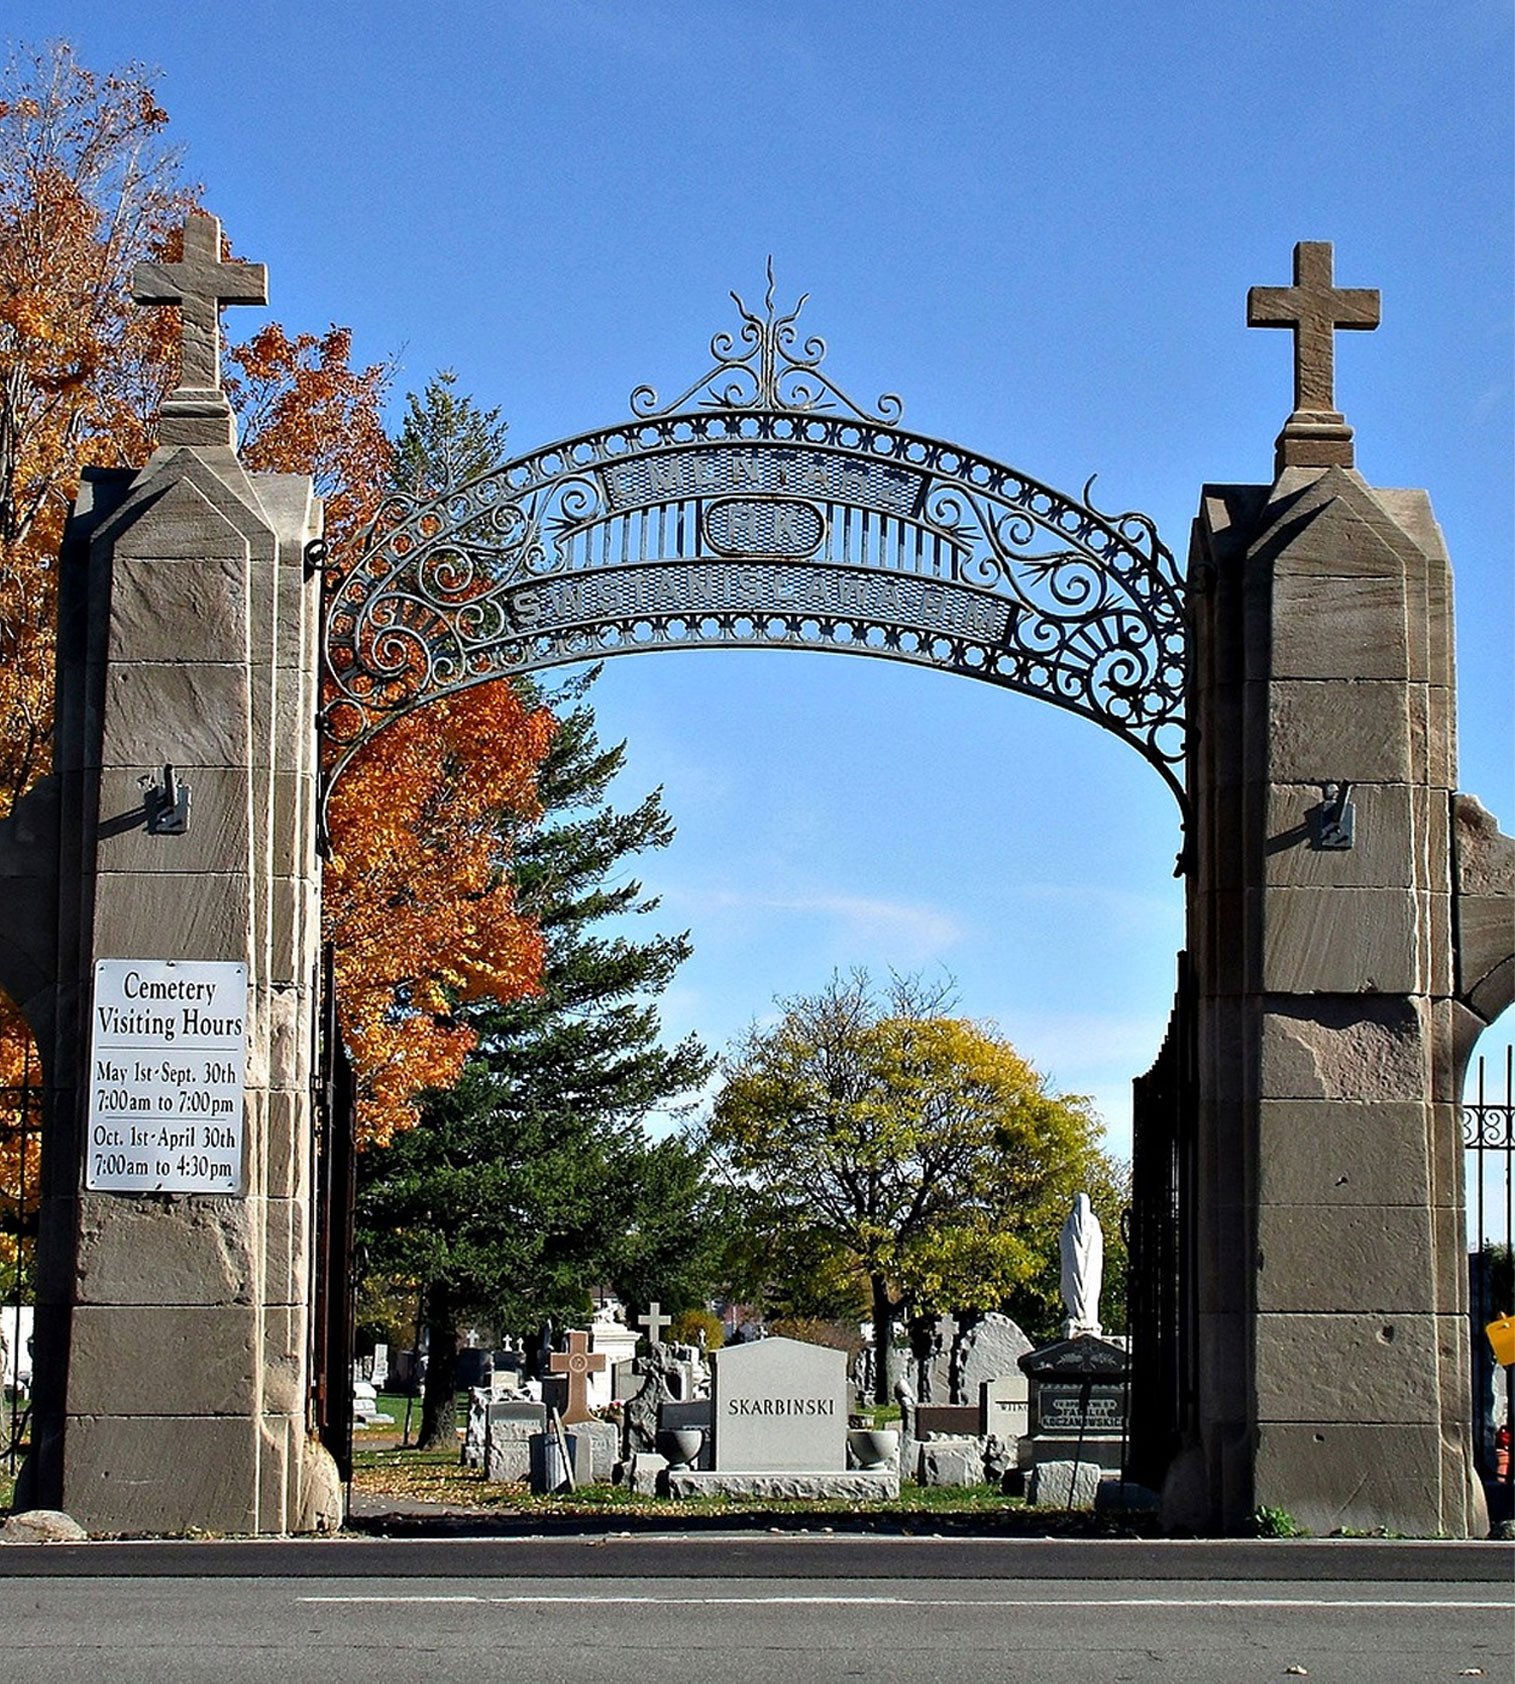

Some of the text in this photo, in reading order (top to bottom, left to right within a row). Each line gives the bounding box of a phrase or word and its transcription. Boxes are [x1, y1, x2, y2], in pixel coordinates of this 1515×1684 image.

[611, 454, 907, 502] CMENTARZ
[124, 971, 217, 1006] Cemetery
[98, 1006, 242, 1041] Visiting Hours
[97, 1061, 128, 1085] May
[203, 1062, 236, 1084] 30th
[97, 1089, 234, 1116] 7:00am to 7:00pm
[94, 1125, 123, 1147] Oct.
[202, 1127, 236, 1148] 30th
[95, 1154, 232, 1181] 7:00am to 4:30pm
[728, 1400, 834, 1415] SKARBINSKI
